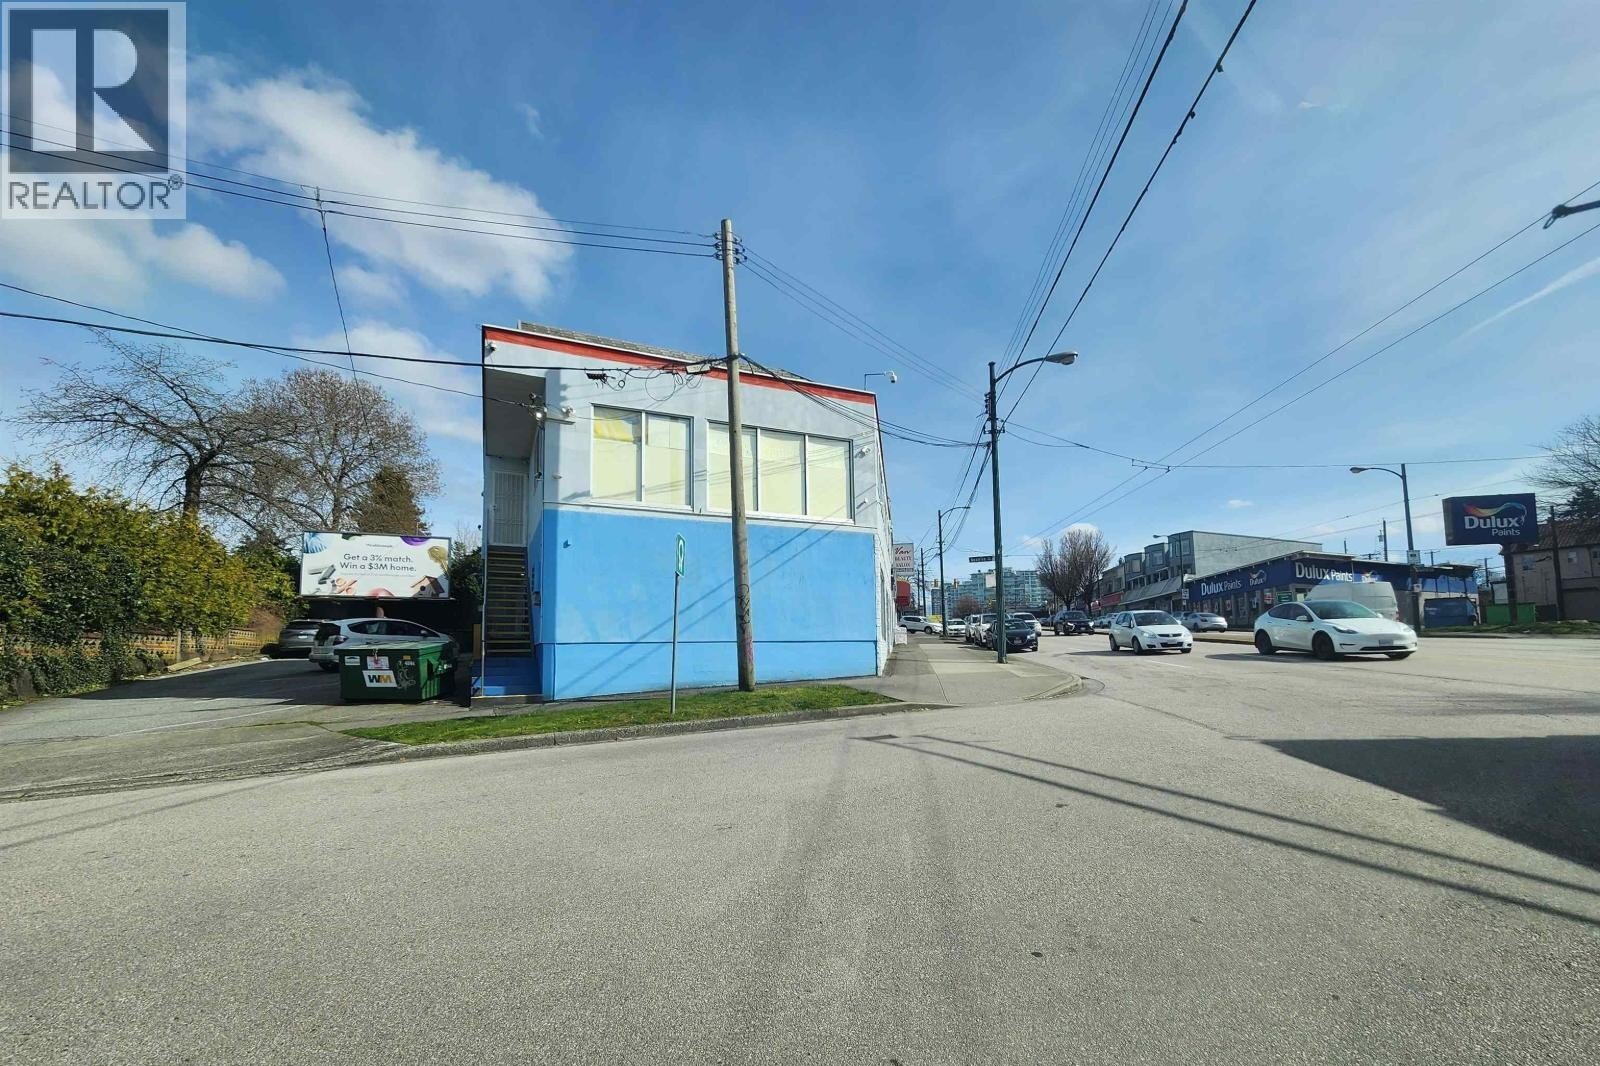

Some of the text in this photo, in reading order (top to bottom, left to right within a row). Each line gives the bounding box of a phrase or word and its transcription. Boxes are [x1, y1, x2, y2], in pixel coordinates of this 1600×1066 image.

[1464, 516, 1519, 529] Dulux
[1492, 528, 1521, 536] Paints
[343, 553, 360, 561] Get
[370, 554, 382, 562] 3%
[340, 561, 358, 570] Win
[368, 562, 388, 571] $3M
[390, 563, 417, 572] home.
[1295, 562, 1353, 582] Dulux Paints
[1201, 582, 1224, 596] Dulux
[1223, 580, 1241, 591] Paints
[367, 675, 393, 683] WM
